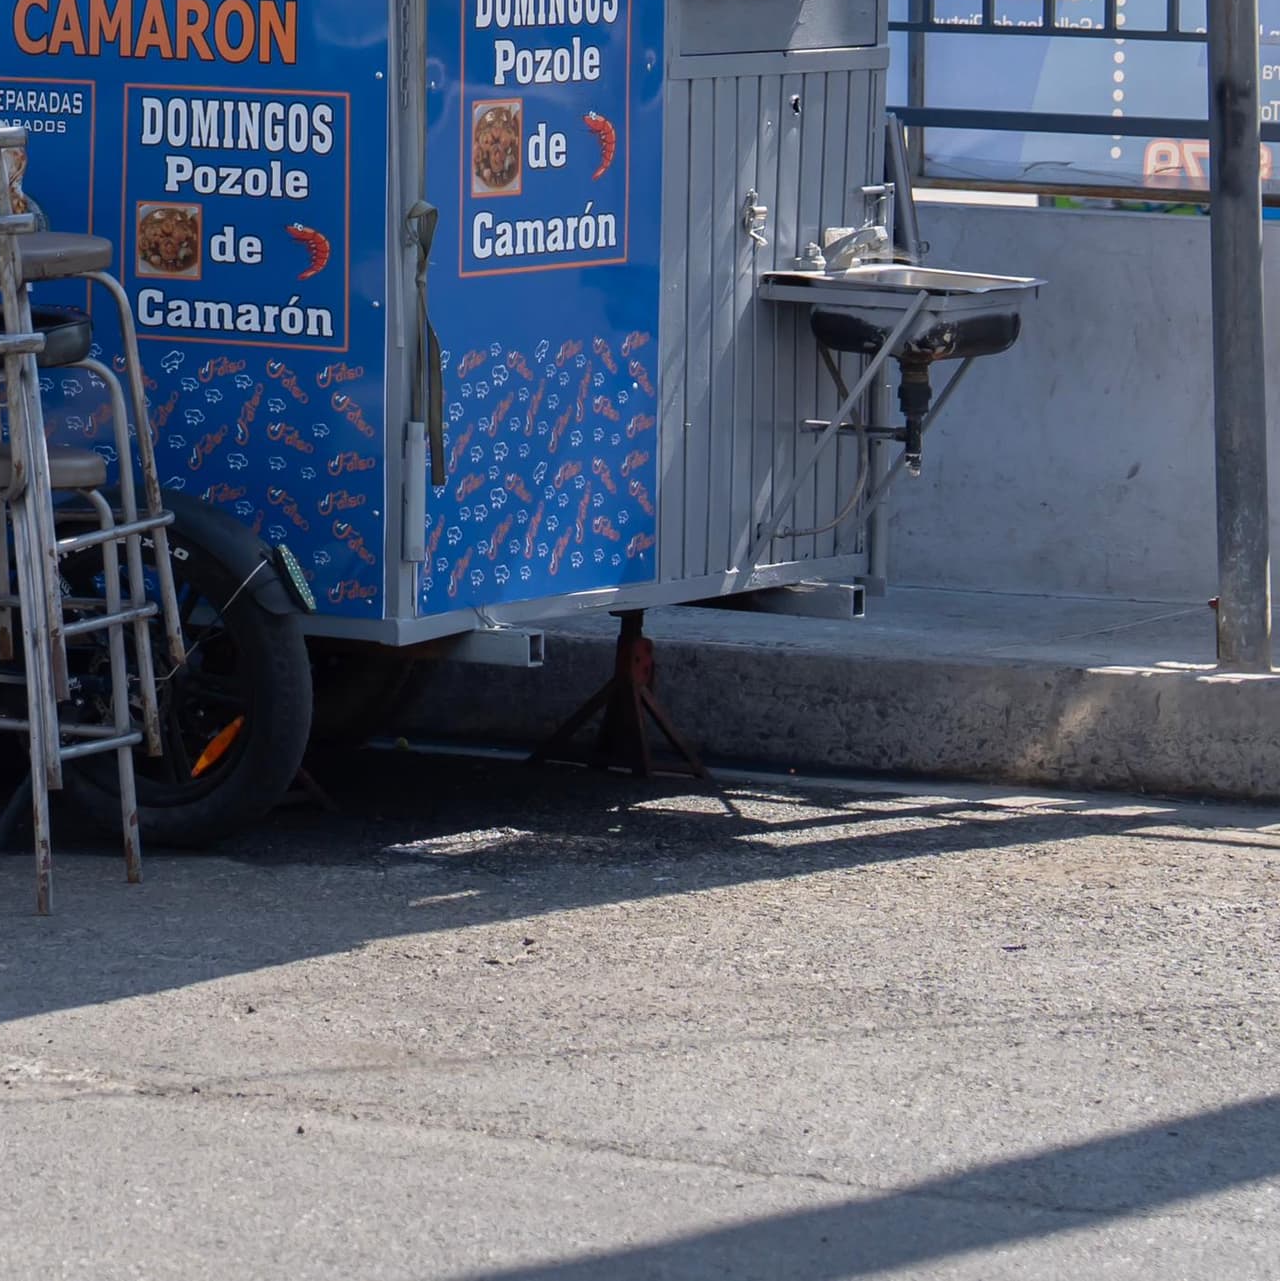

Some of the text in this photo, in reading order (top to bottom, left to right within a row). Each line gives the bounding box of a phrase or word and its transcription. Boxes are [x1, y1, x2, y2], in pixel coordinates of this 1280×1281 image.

[494, 36, 600, 85] Pozole
[141, 97, 334, 154] DOMINGOS
[527, 123, 568, 169] de
[165, 155, 309, 199] Pozole
[210, 226, 263, 264] de
[473, 202, 617, 259] Camarón
[137, 288, 334, 337] Camarón
